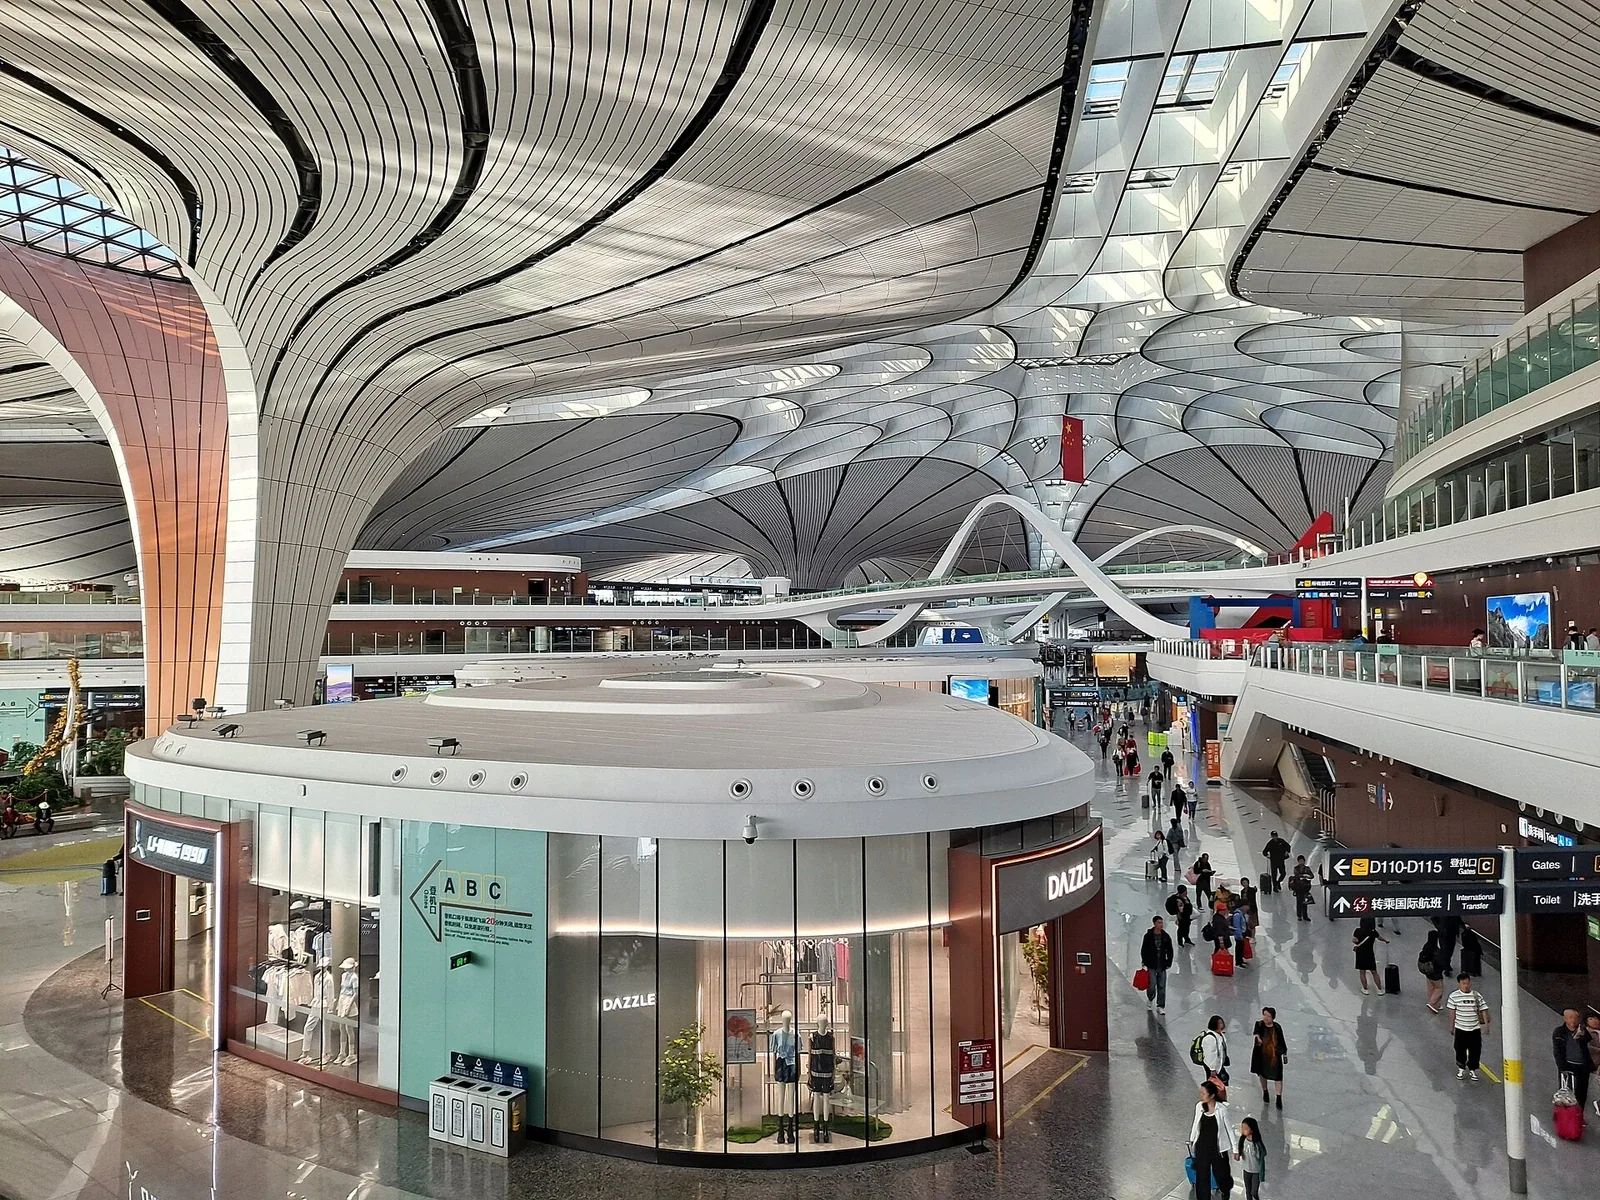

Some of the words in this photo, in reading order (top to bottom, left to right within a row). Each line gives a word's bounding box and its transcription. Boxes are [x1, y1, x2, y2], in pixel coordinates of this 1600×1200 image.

[1369, 860, 1443, 874] D110-D115
[1450, 858, 1477, 868] 登机口
[1481, 861, 1491, 871] C
[1532, 860, 1561, 870] Gates
[1048, 858, 1093, 900] DAZZLE
[444, 878, 455, 894] A
[466, 880, 477, 896] B
[489, 882, 501, 900] C
[1456, 893, 1496, 901] International
[1533, 895, 1561, 905] Toilet
[1371, 897, 1443, 911] 转乘国际航班
[1462, 902, 1489, 910] Transfer
[602, 993, 656, 1011] DAZZLE
